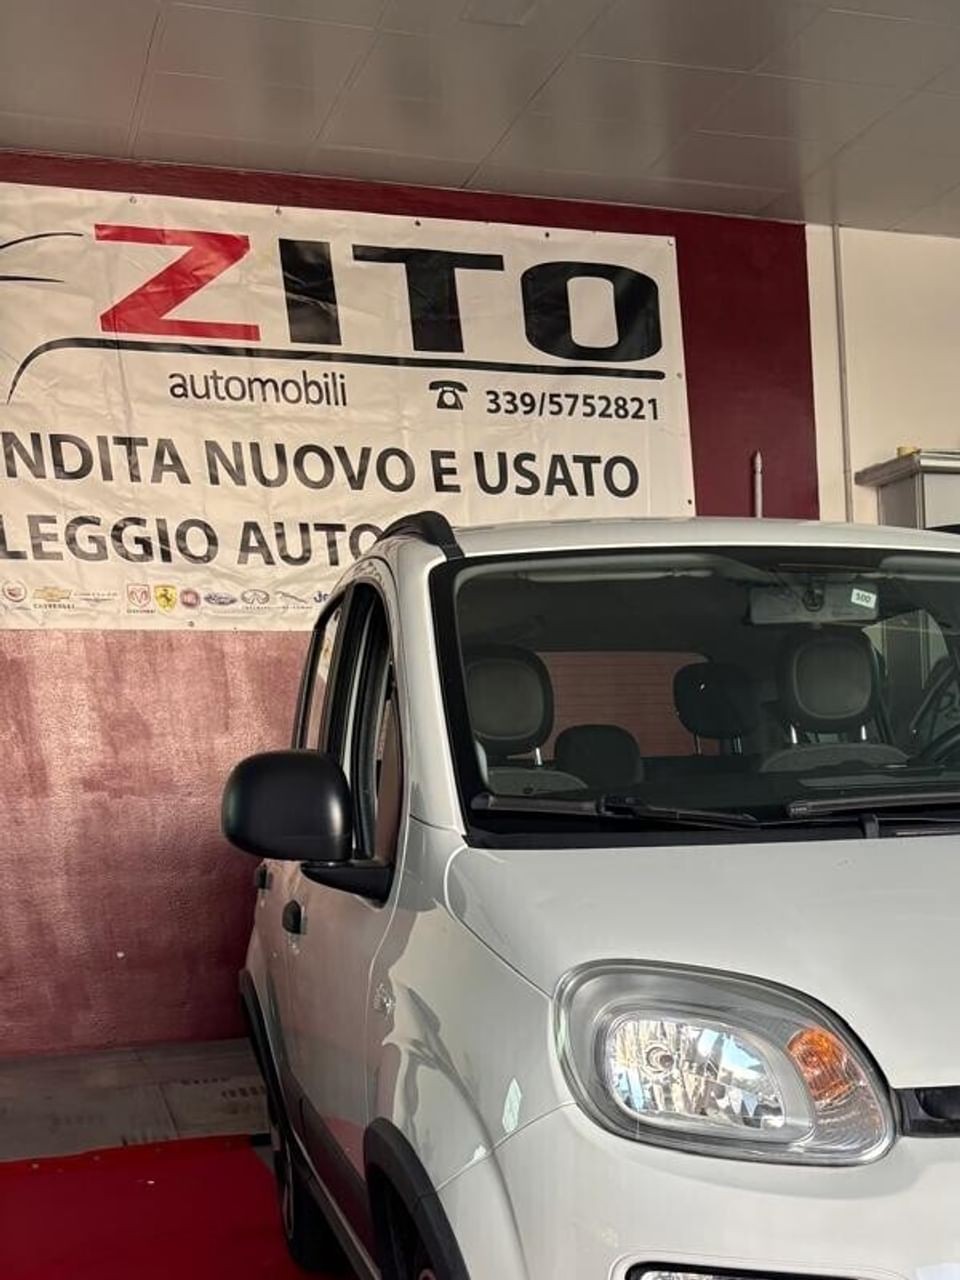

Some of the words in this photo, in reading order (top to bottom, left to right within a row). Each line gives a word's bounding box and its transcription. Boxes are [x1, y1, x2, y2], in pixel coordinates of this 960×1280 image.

[94, 224, 661, 362] ZITO
[168, 369, 348, 407] automobili
[485, 389, 660, 421] 339/5752821
[0, 431, 191, 484] NDITA
[205, 440, 416, 493] NUOVO
[431, 450, 462, 493] E
[474, 452, 640, 498] USATO
